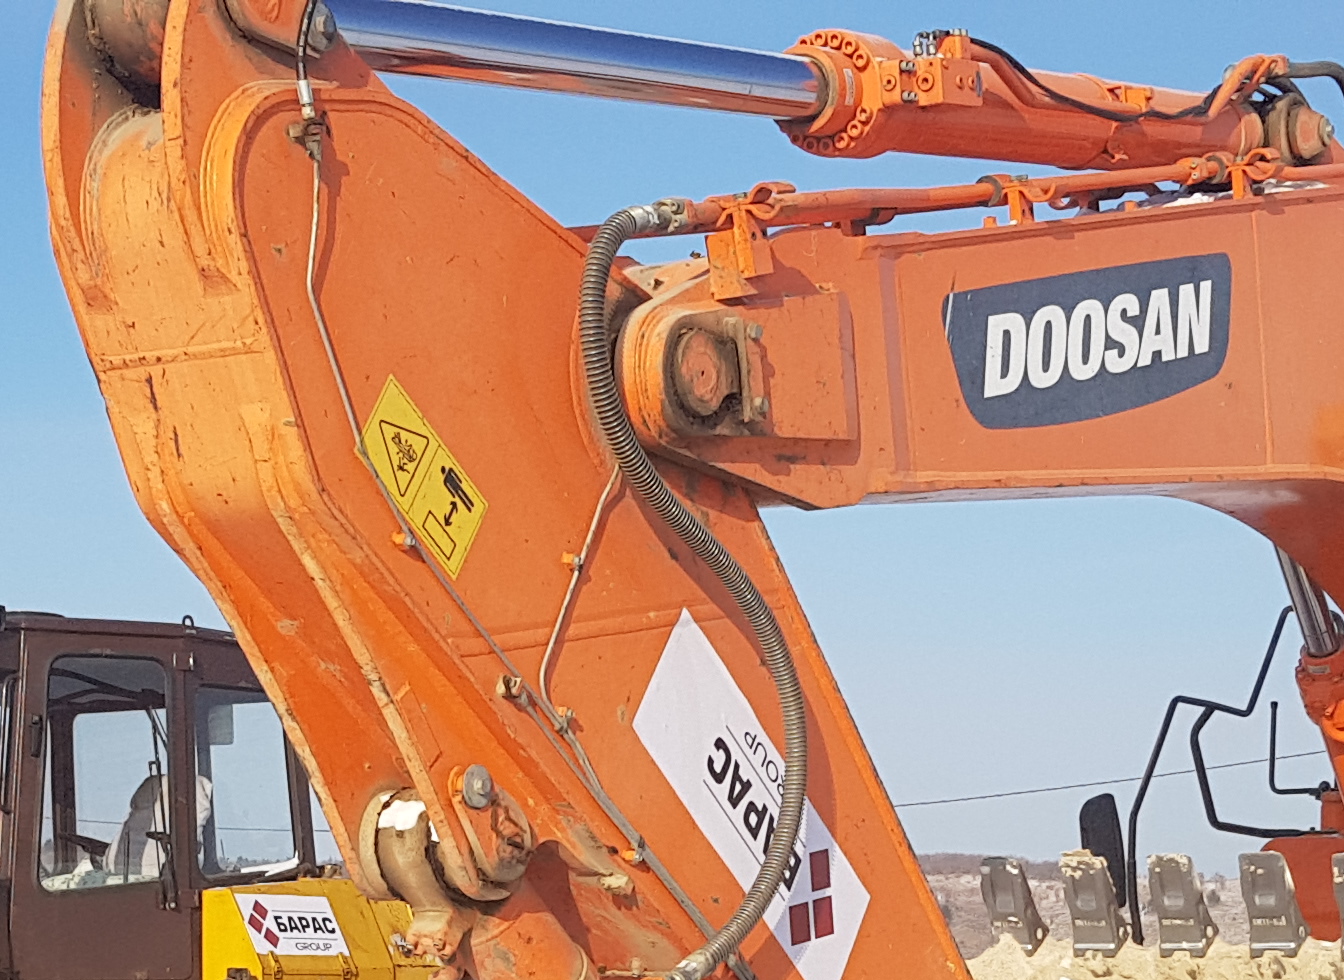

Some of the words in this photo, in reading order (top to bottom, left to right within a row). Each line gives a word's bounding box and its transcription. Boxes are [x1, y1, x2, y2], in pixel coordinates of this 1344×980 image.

[983, 279, 1212, 399] DOOSAN
[744, 731, 785, 798] ROUP
[272, 914, 336, 935] БАРАС
[296, 942, 333, 952] GROUP
